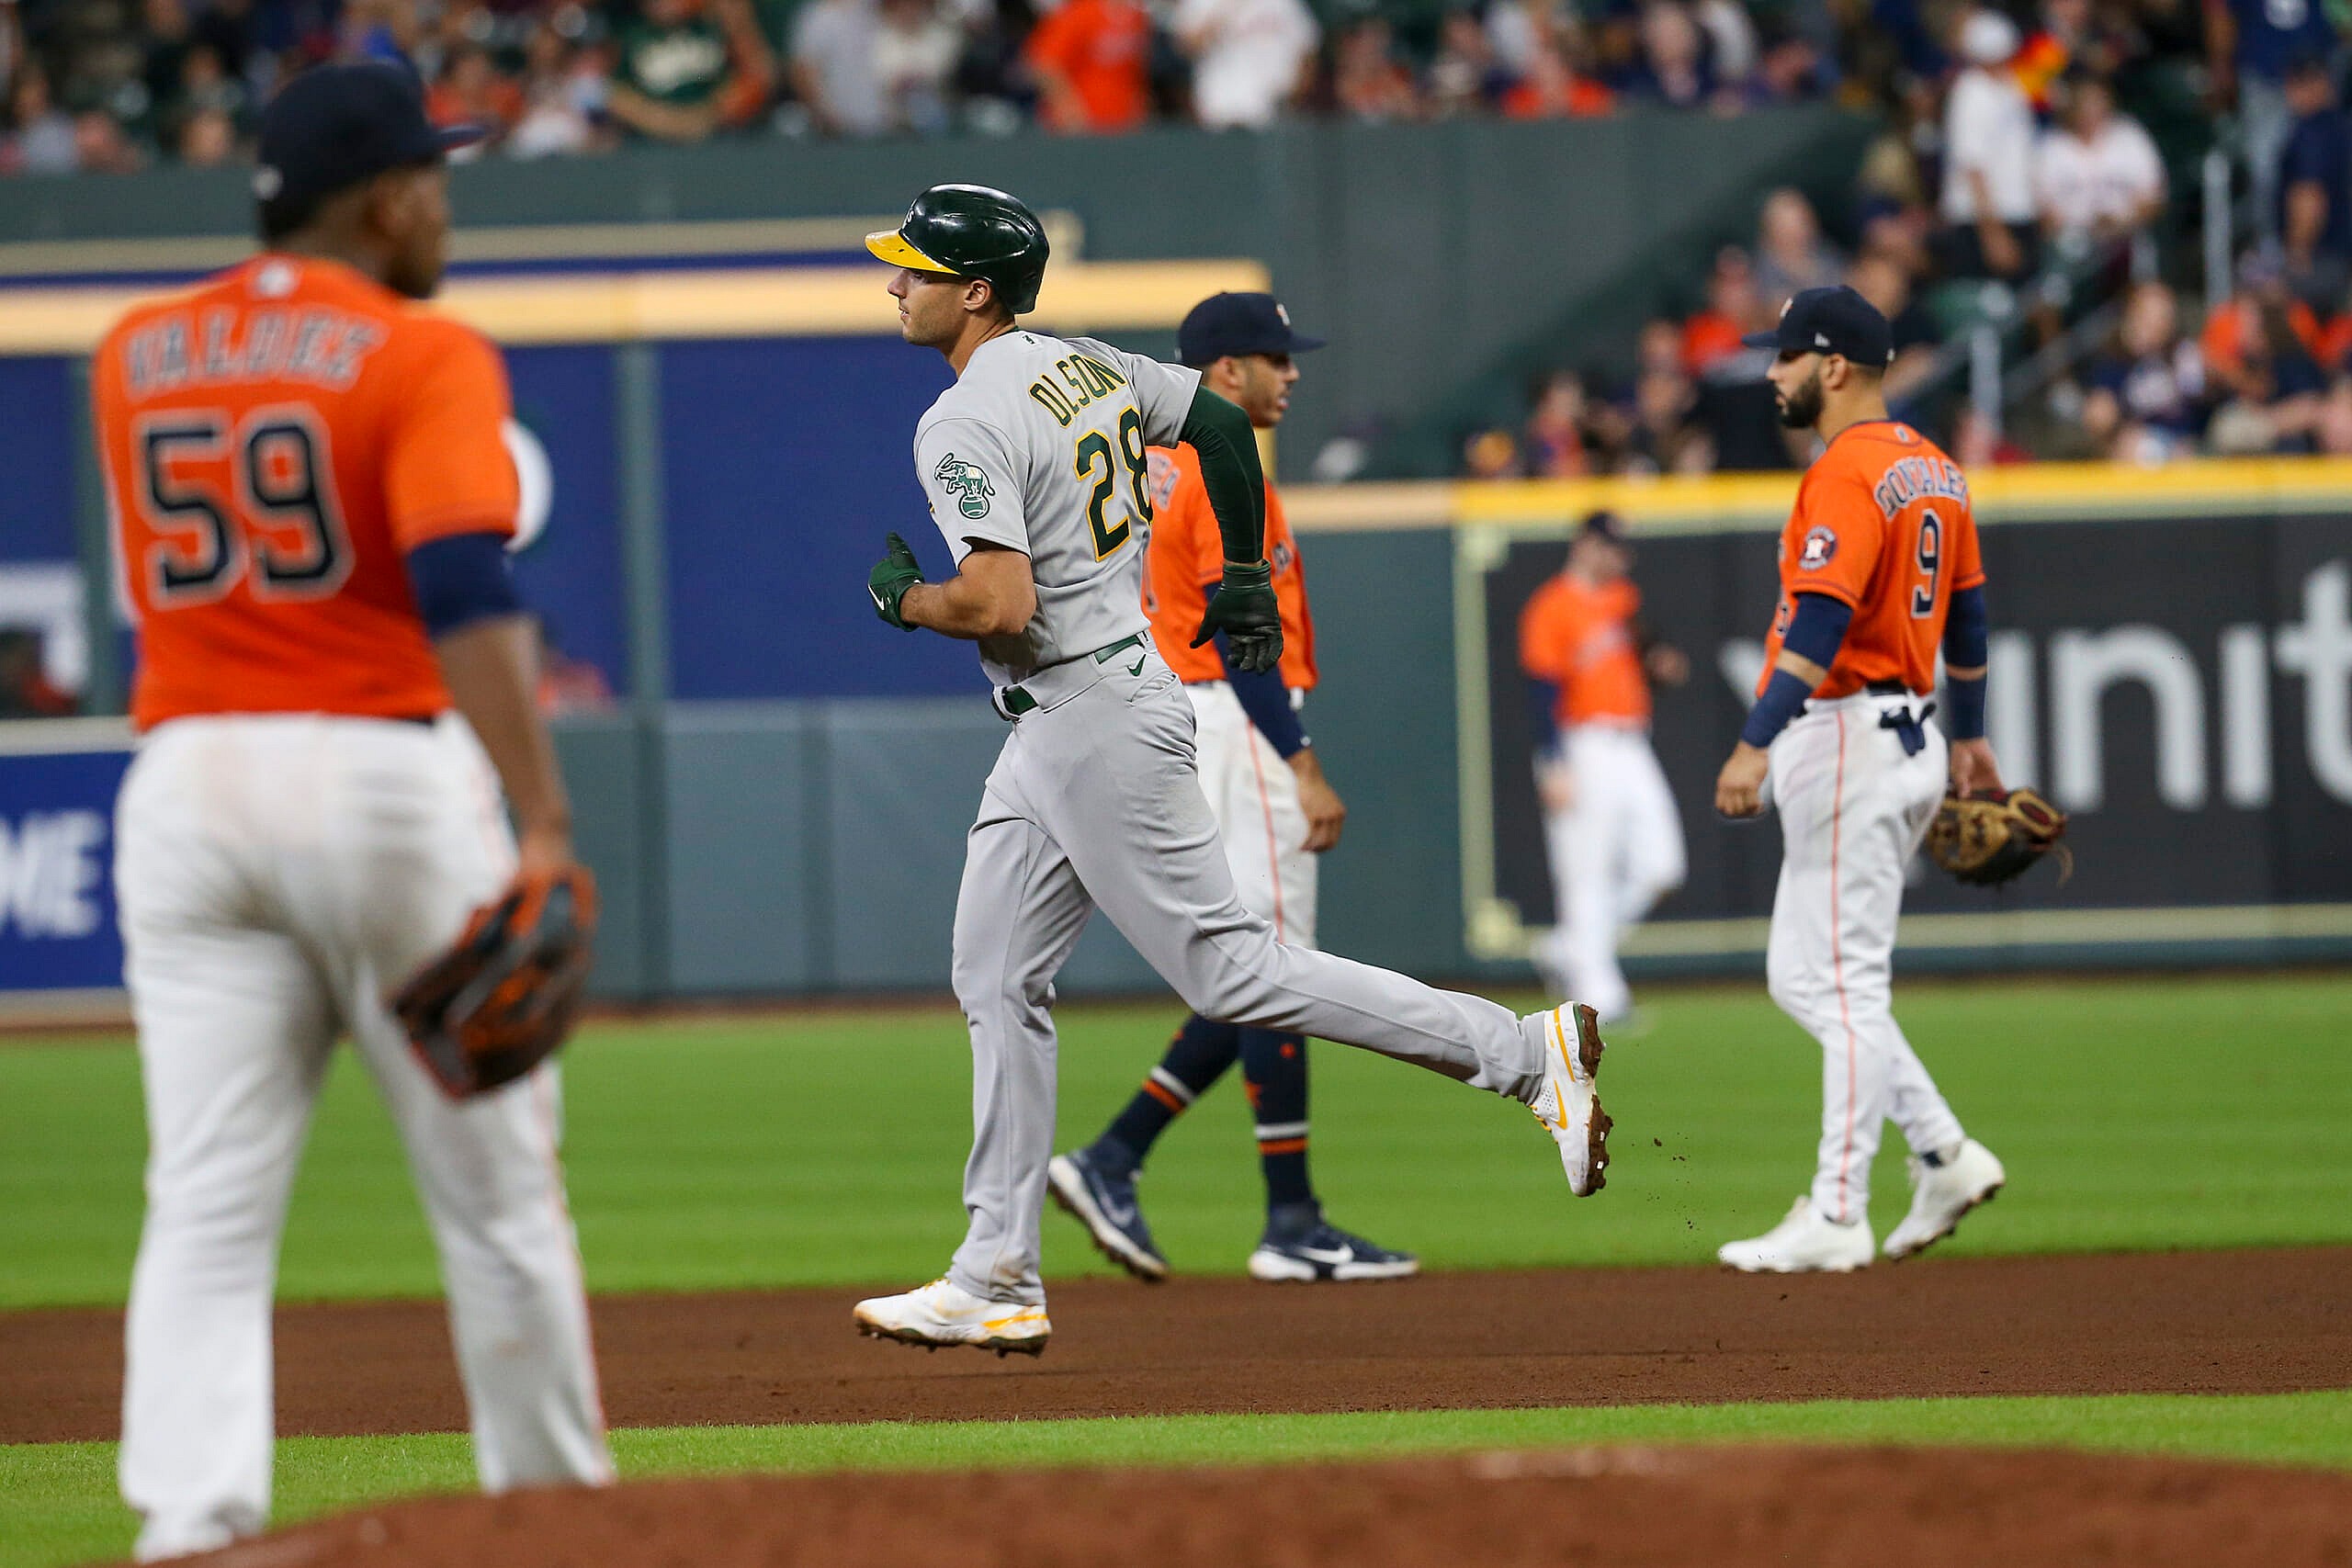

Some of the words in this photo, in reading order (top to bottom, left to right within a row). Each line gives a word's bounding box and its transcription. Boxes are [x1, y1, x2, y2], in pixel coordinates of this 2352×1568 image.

[1028, 354, 1127, 428] OLSON
[130, 401, 356, 610] 59
[1073, 404, 1154, 563] 28
[1910, 508, 1943, 619] 9
